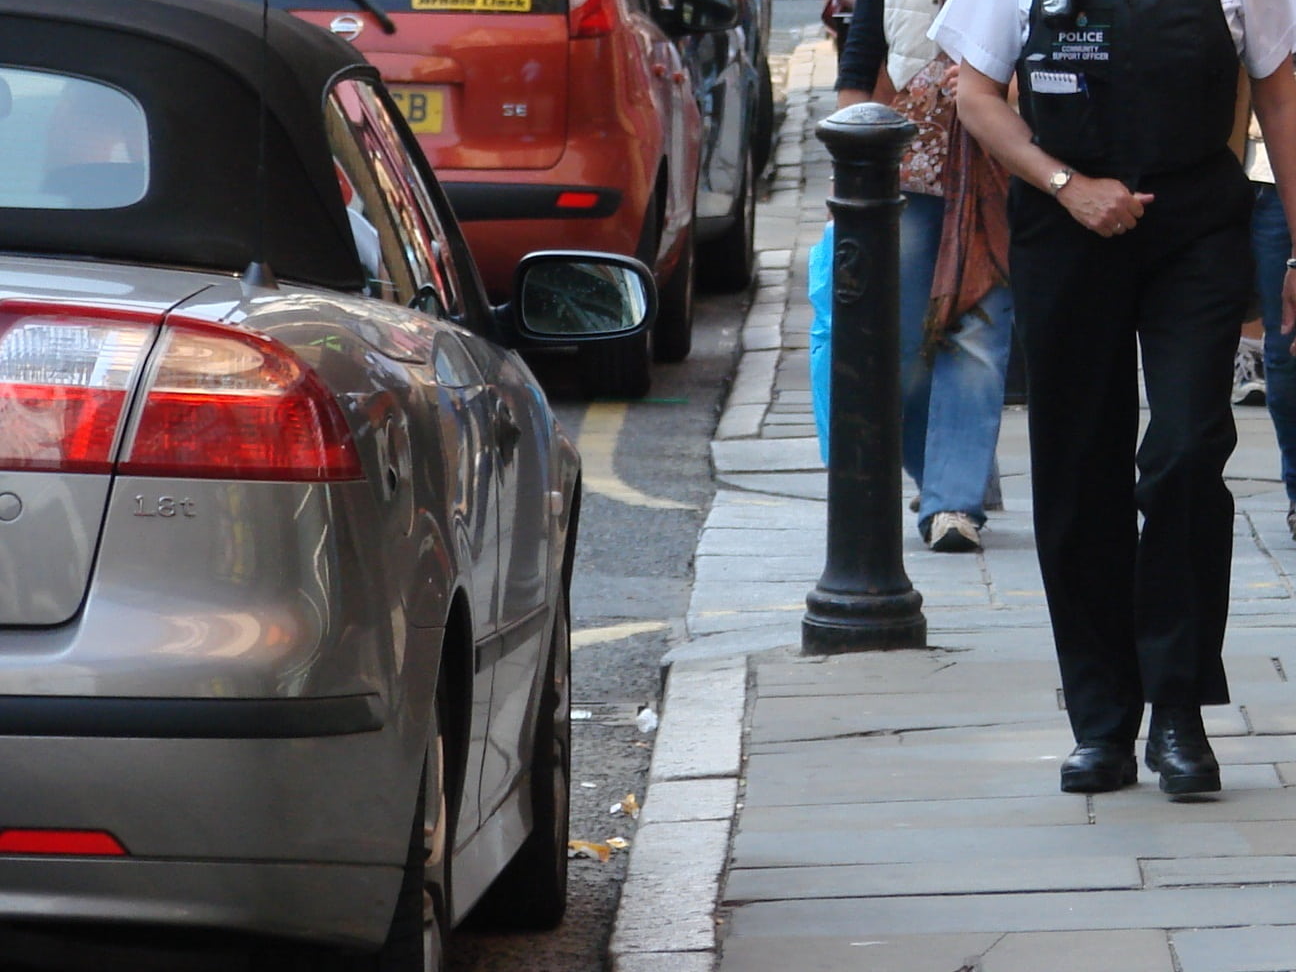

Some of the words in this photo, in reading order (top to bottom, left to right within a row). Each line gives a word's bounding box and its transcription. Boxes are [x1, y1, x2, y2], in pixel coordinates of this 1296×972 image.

[1058, 31, 1104, 43] POLICE
[1061, 45, 1099, 53] COMMUNITY
[1052, 52, 1081, 61] SUPPORT
[1082, 52, 1109, 61] OFFICER
[502, 103, 528, 117] SE
